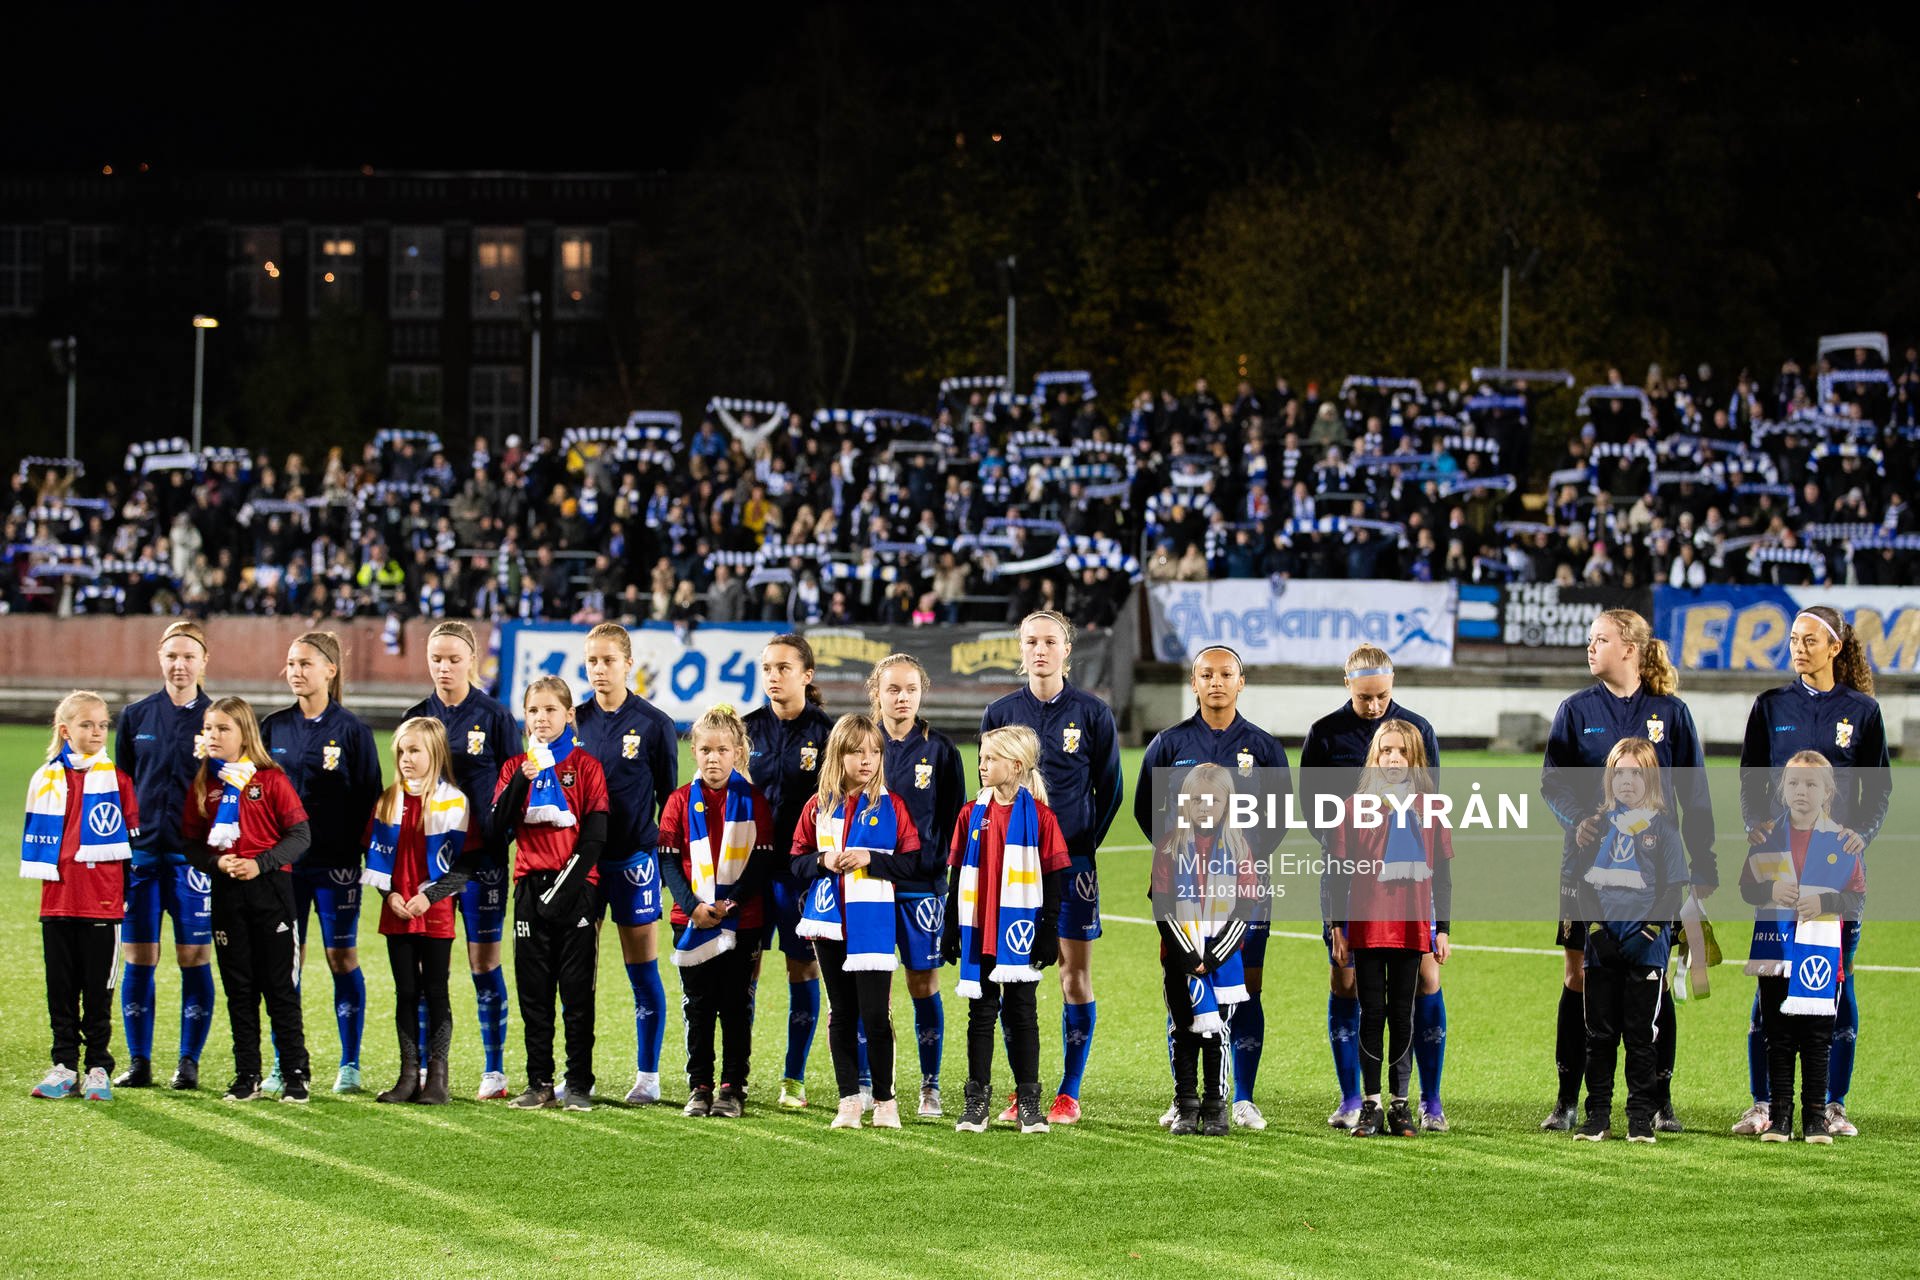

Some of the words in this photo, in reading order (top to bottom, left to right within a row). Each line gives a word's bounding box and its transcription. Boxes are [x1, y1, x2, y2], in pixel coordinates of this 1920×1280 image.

[1505, 582, 1560, 604] THE
[1169, 590, 1390, 648] Änglarna
[1505, 603, 1603, 625] BROWN
[1504, 624, 1592, 646] BOMB
[1680, 603, 1920, 672] FRM
[370, 840, 394, 854] IXLY
[216, 931, 228, 946] FG
[516, 921, 530, 937] EH
